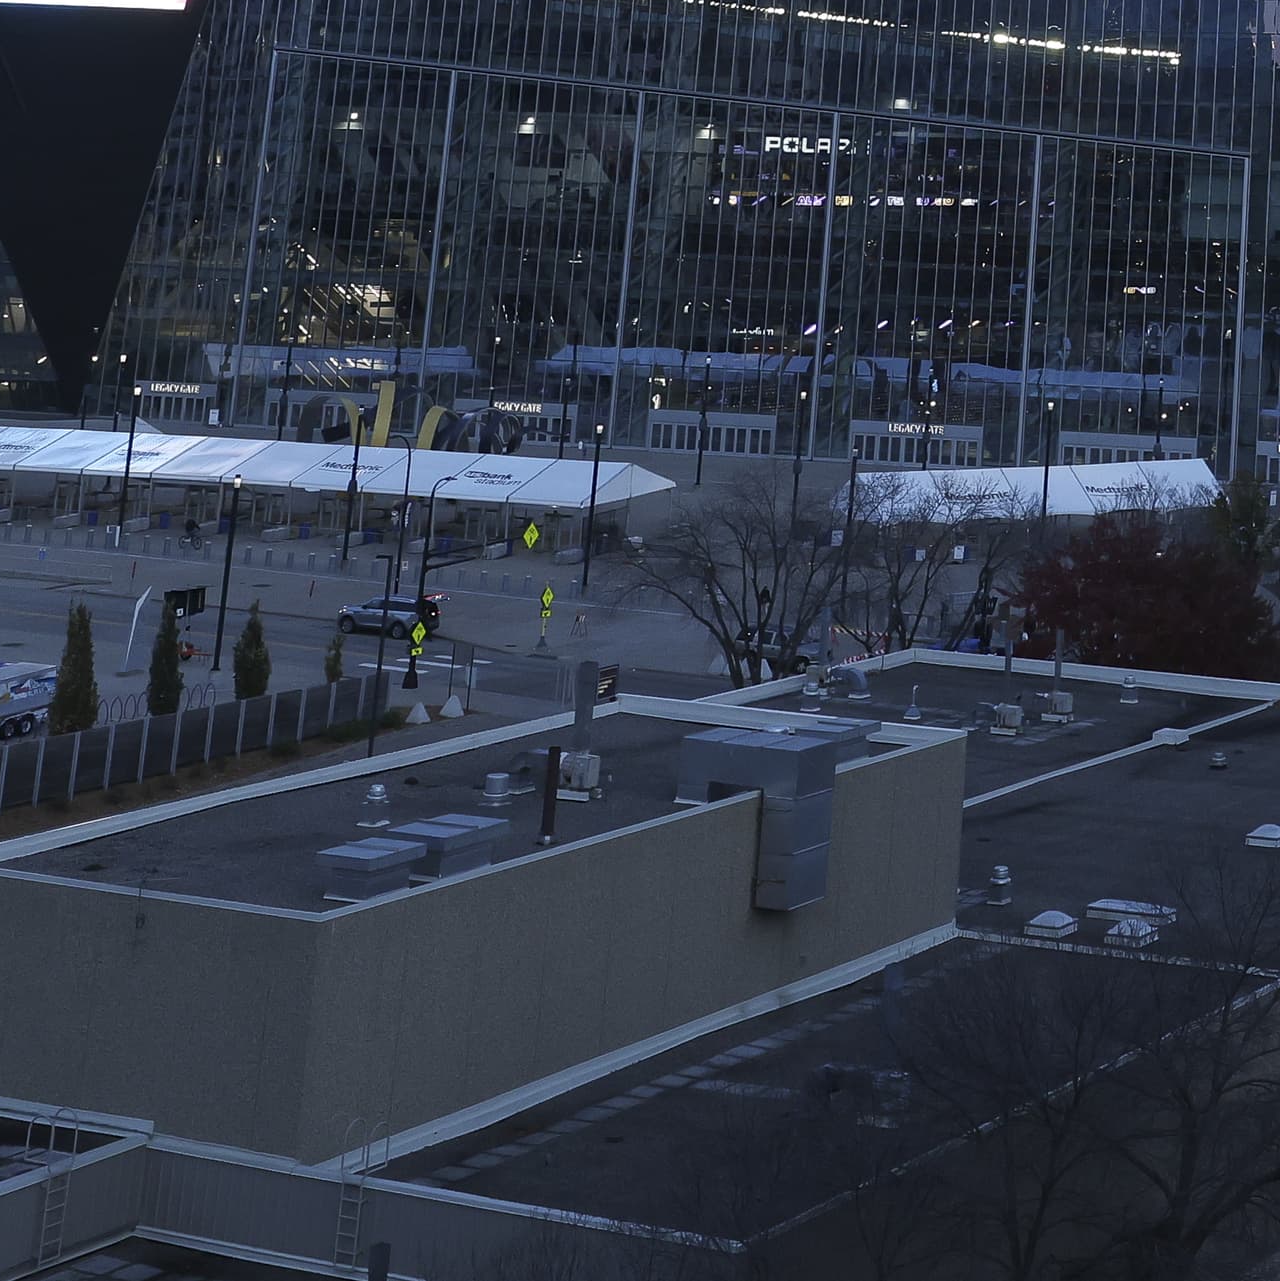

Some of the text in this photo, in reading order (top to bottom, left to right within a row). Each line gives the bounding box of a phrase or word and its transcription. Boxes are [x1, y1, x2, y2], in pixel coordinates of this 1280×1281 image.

[150, 383, 200, 394] LEGACY GATE
[493, 401, 542, 414] EGACY GATE
[888, 423, 921, 434] LEGACY
[321, 461, 383, 472] Medtonic
